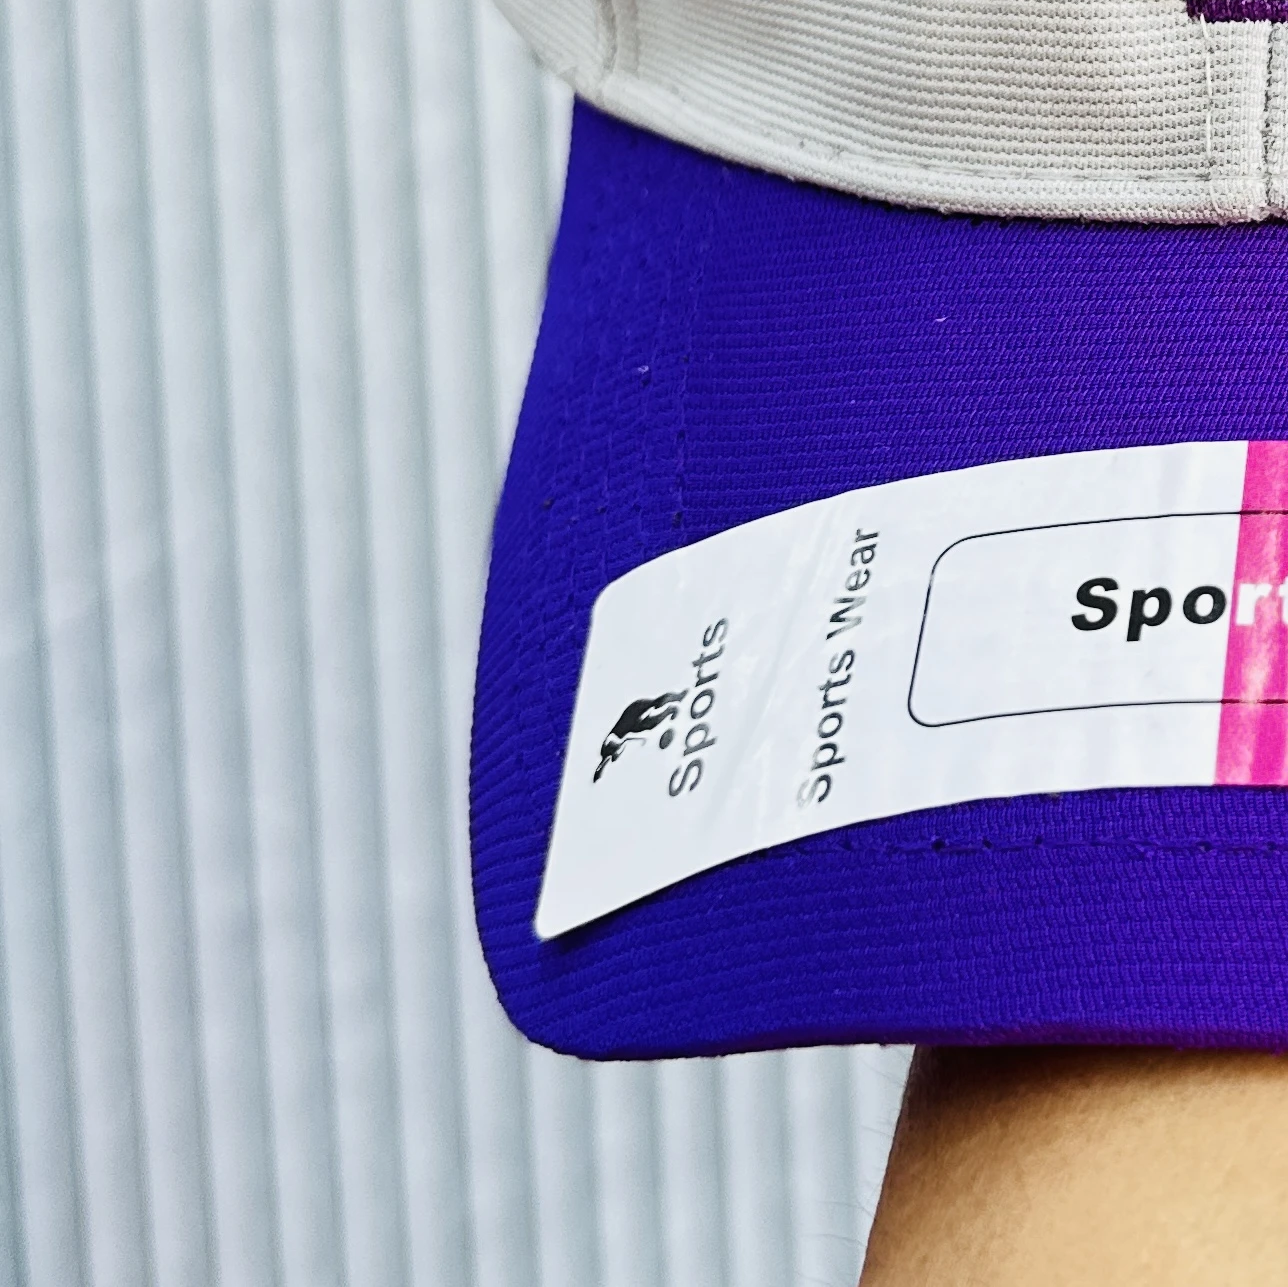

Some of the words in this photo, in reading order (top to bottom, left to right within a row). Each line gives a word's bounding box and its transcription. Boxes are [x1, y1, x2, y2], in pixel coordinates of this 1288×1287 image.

[669, 617, 729, 797] Sports
[796, 648, 856, 808] Sports
[826, 528, 879, 640] Wear
